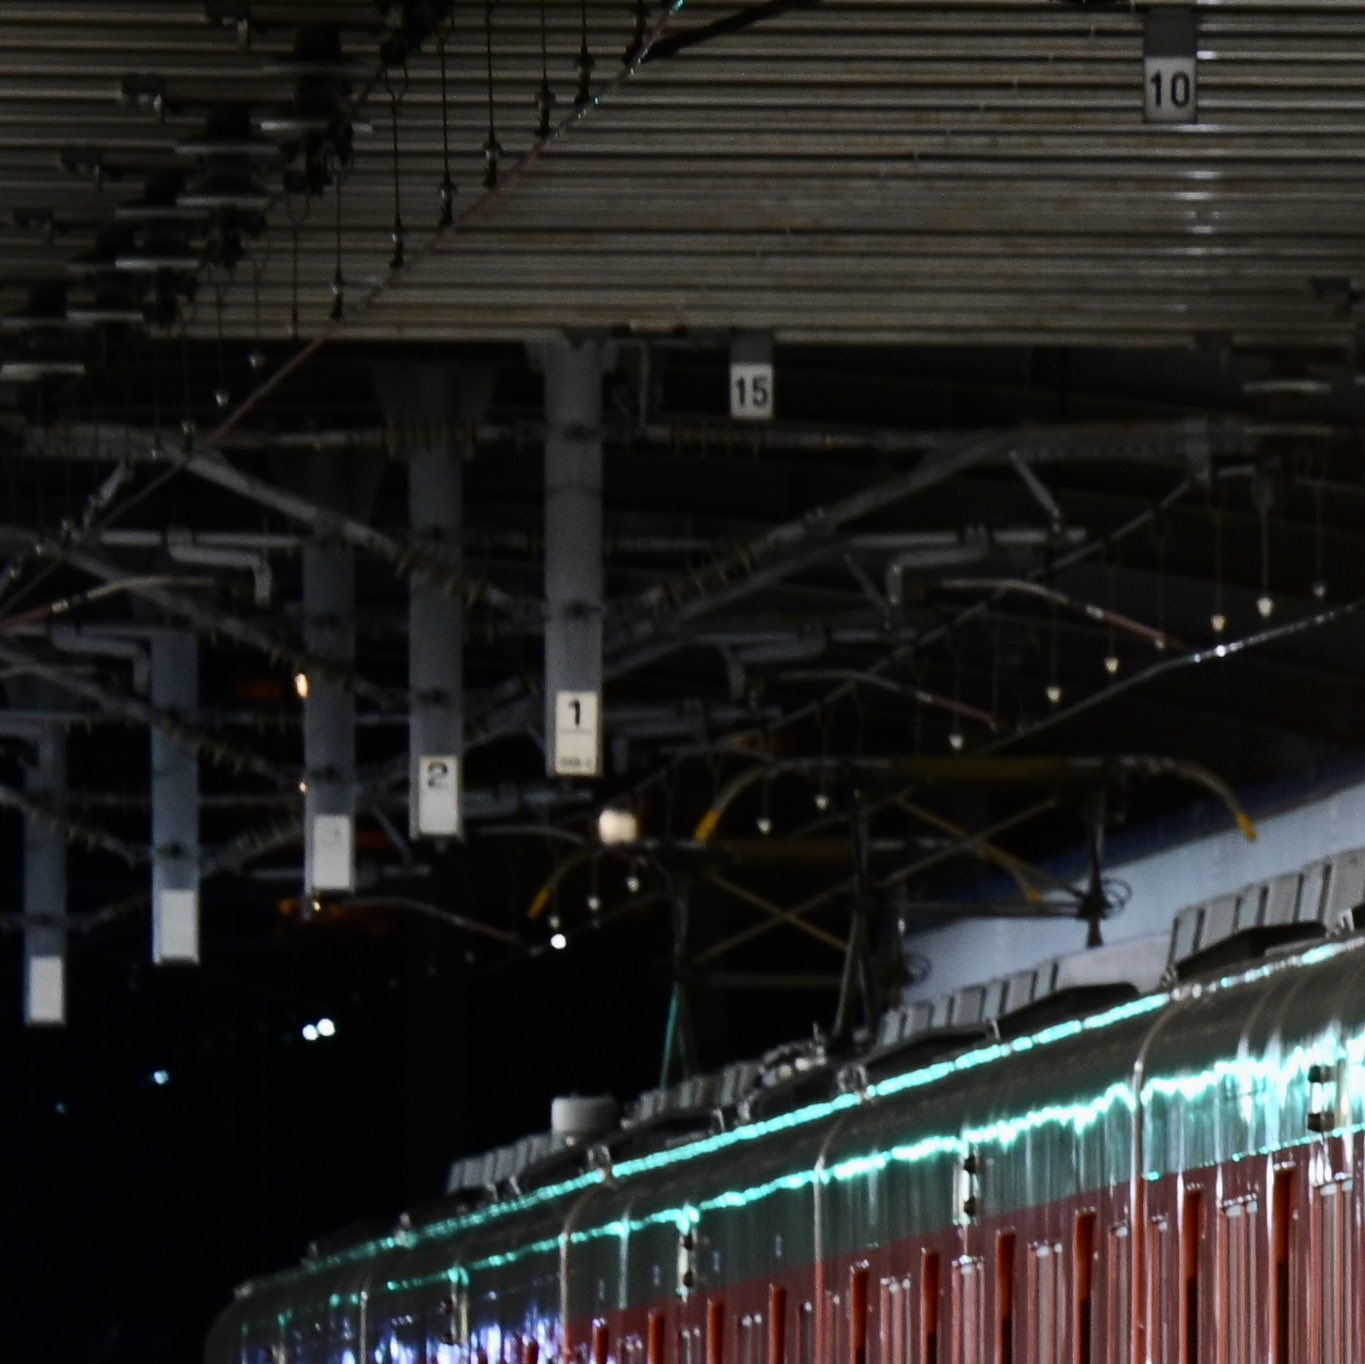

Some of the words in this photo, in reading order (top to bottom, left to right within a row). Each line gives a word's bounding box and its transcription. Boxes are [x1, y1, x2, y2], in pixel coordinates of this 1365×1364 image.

[1150, 70, 1190, 108] 10
[736, 376, 769, 408] 15
[569, 699, 581, 727] 1
[427, 760, 449, 790] 2
